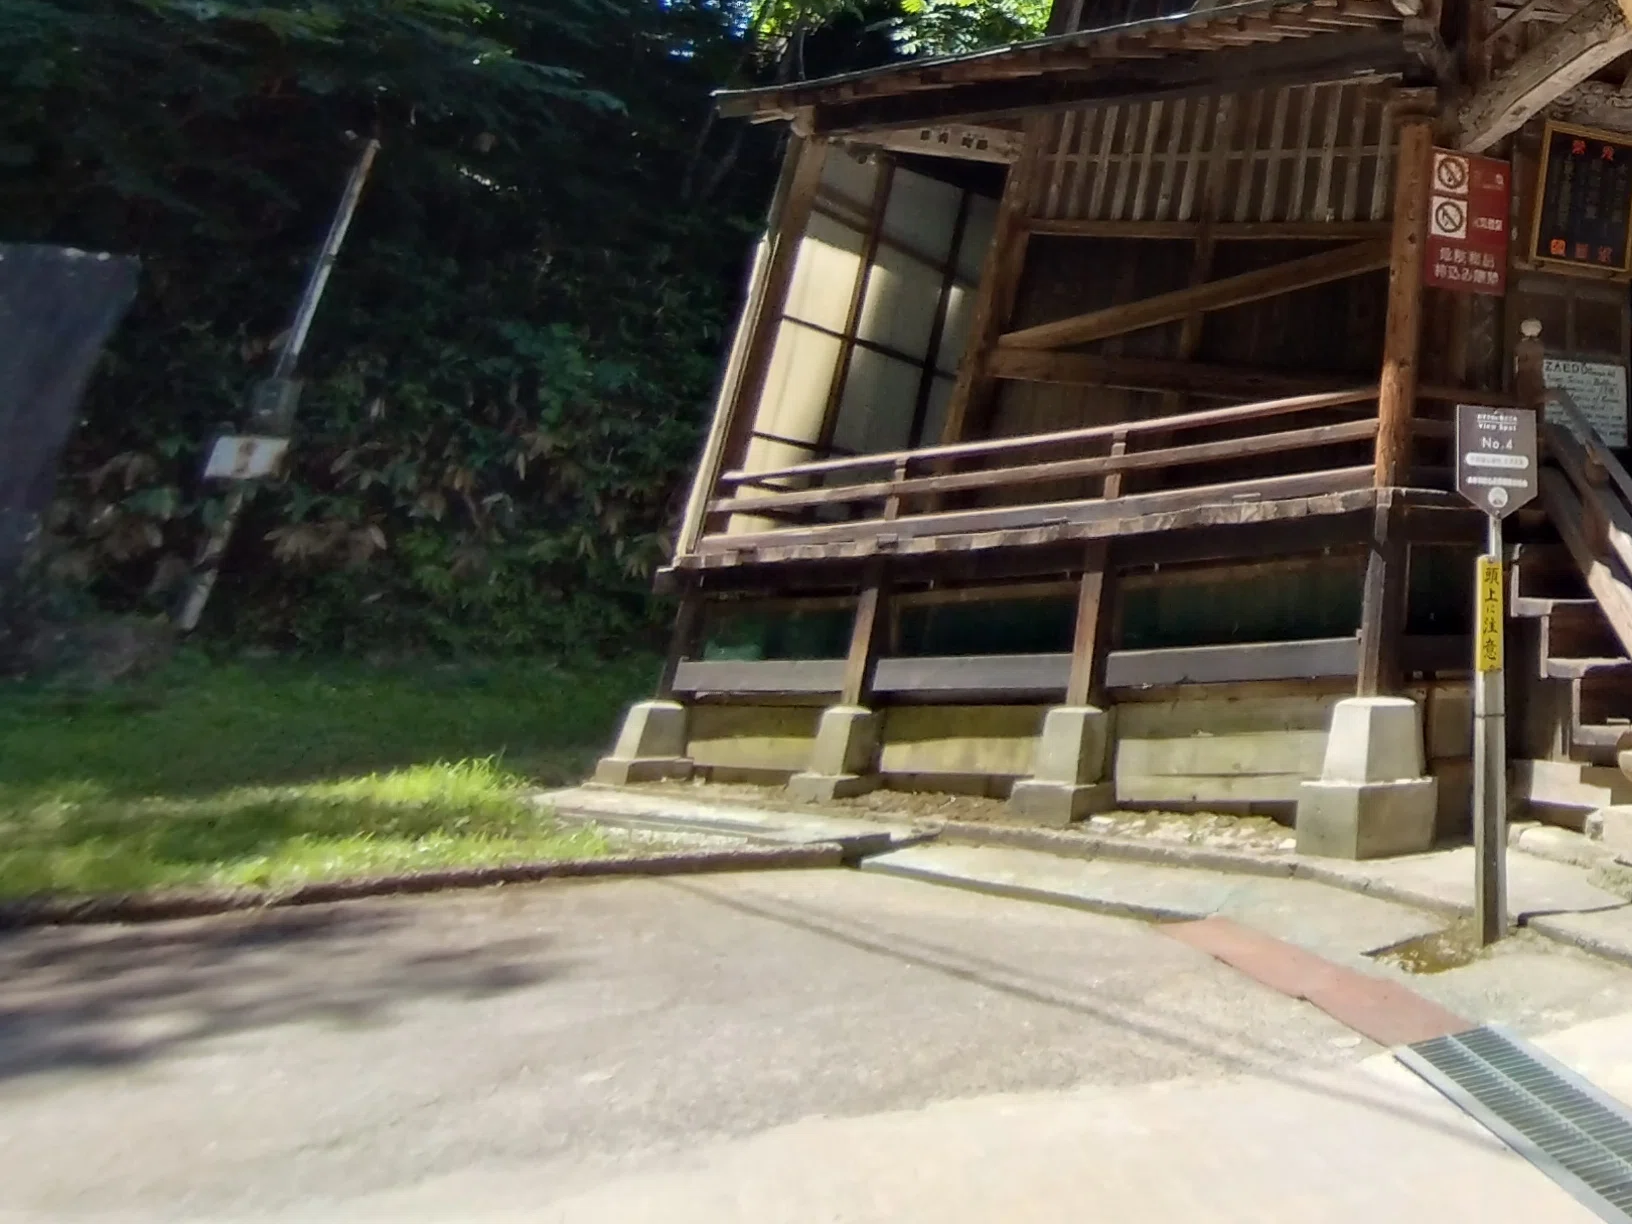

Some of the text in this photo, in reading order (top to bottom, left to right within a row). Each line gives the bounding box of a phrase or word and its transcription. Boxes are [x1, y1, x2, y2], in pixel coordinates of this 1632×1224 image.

[1483, 567, 1500, 660] 頭上に注意
